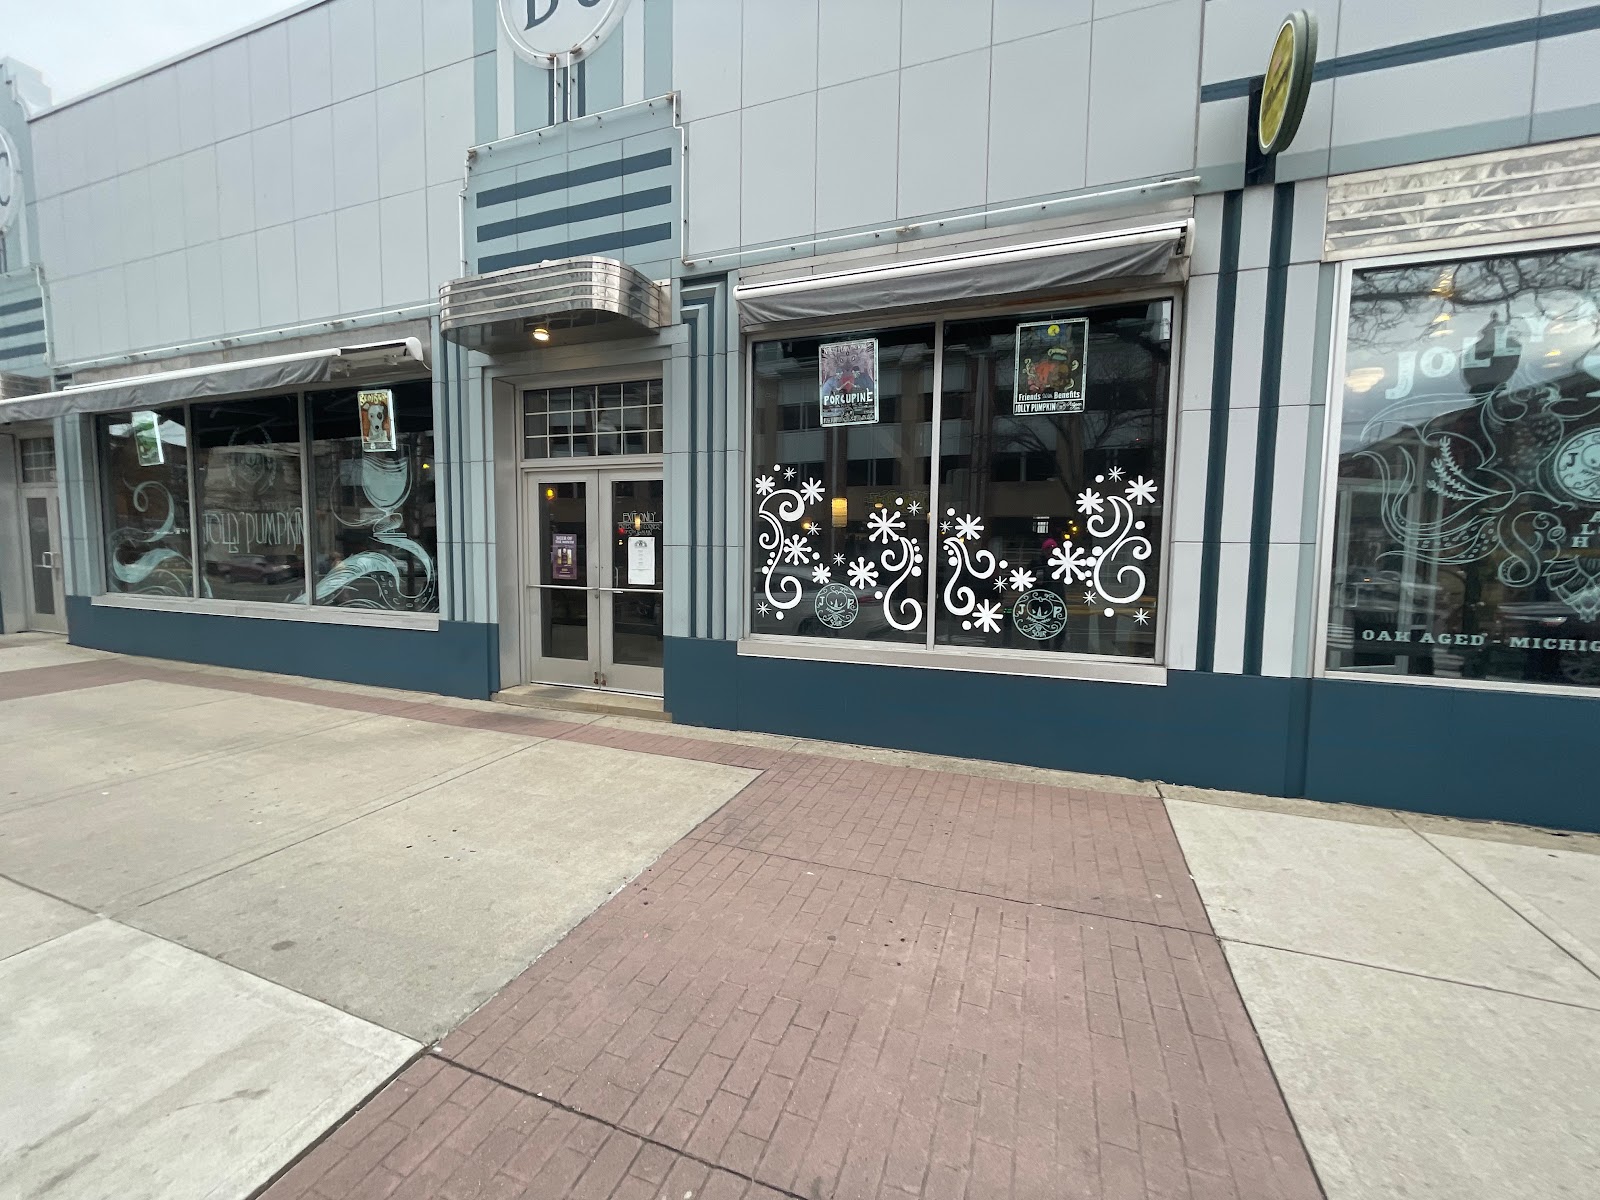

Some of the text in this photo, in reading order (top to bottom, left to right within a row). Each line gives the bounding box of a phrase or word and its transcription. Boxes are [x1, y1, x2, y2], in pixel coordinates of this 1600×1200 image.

[1384, 311, 1551, 400] JOLLY
[823, 387, 874, 406] PORCUPINE
[1019, 393, 1041, 401] Friends
[1053, 391, 1081, 400] Benefits
[1015, 403, 1030, 413] JOLLY
[1031, 402, 1056, 412] PUMPKIN
[1419, 631, 1486, 646] AGED
